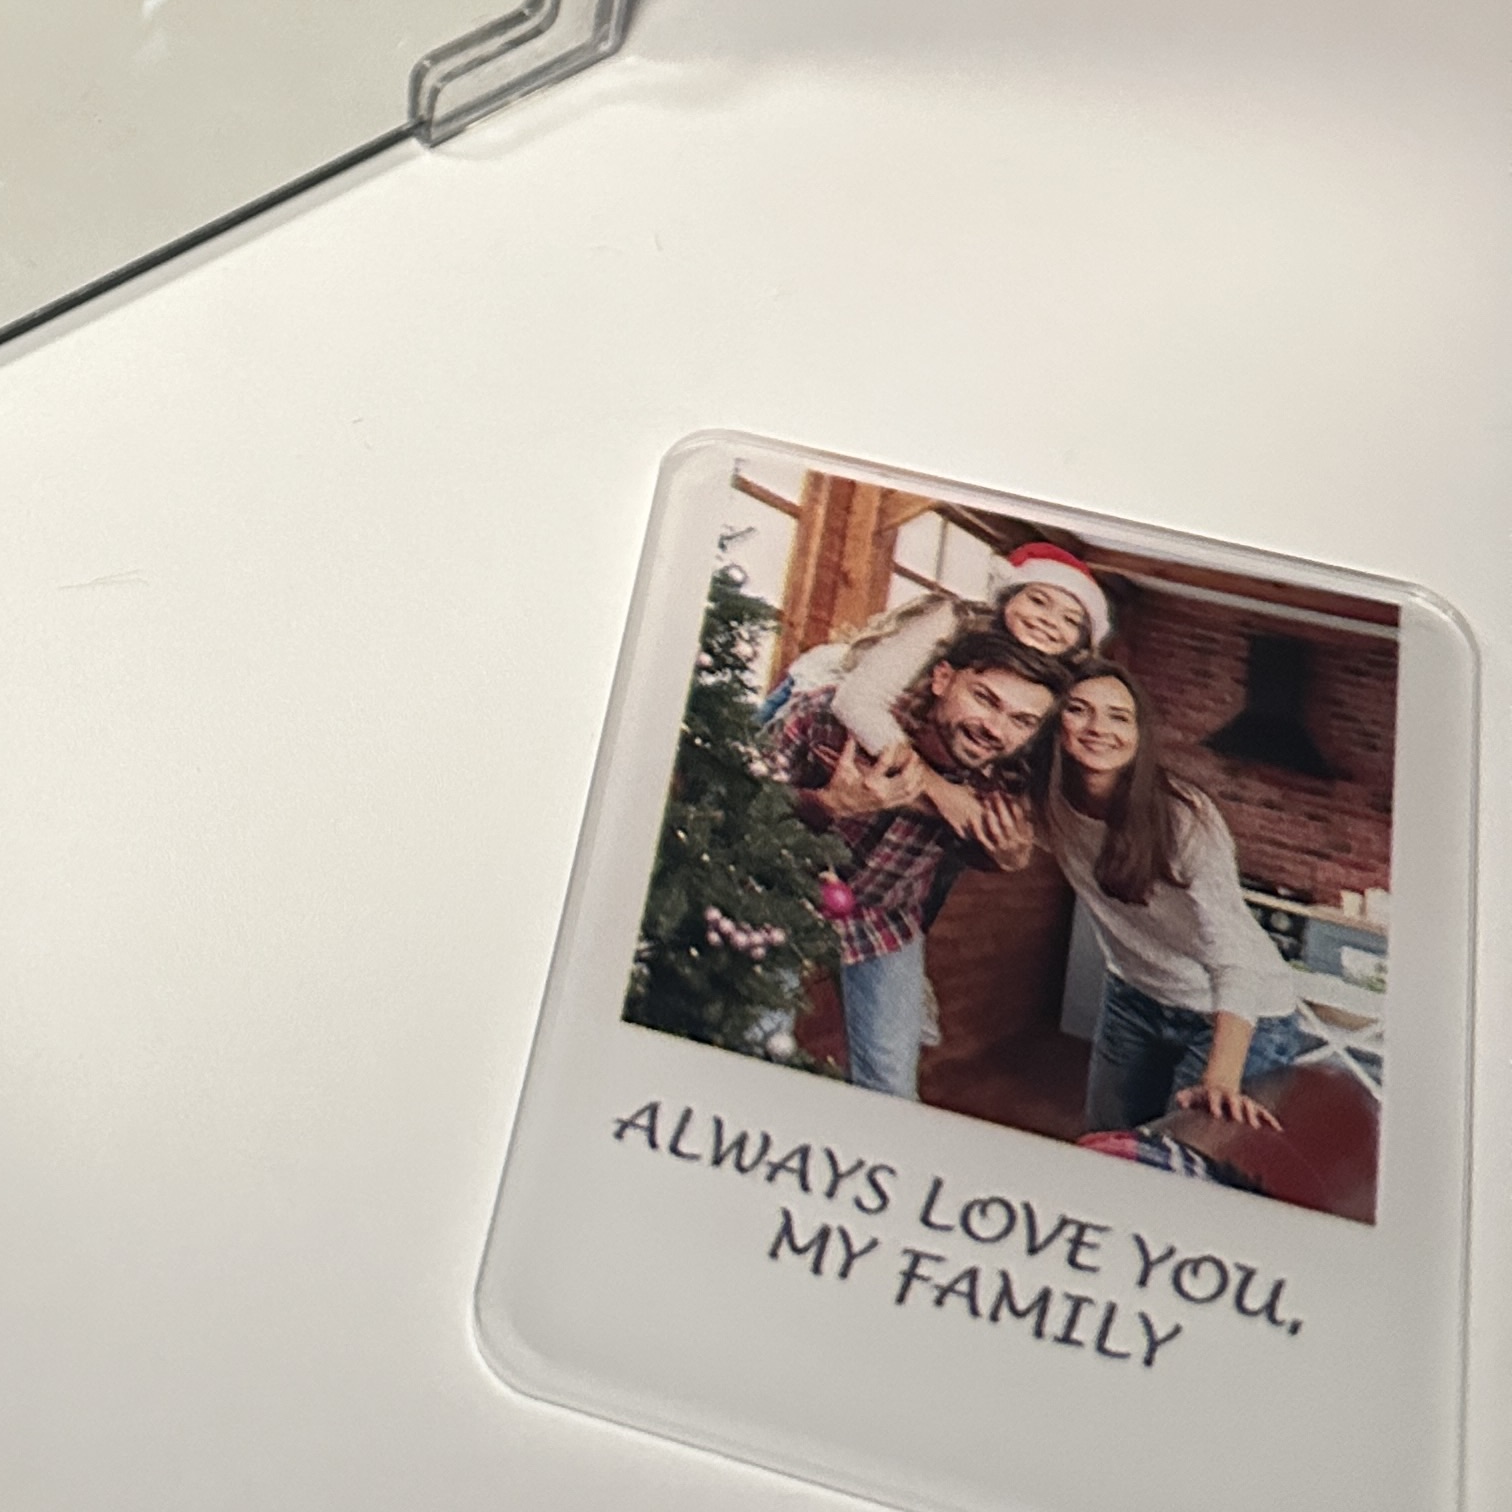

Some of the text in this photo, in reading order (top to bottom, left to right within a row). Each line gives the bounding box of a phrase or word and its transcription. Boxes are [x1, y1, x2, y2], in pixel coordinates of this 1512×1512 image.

[612, 1099, 898, 1217] ALWAYS
[918, 1175, 1113, 1275] LOVE
[767, 1206, 1184, 1369] MY FAMILY
